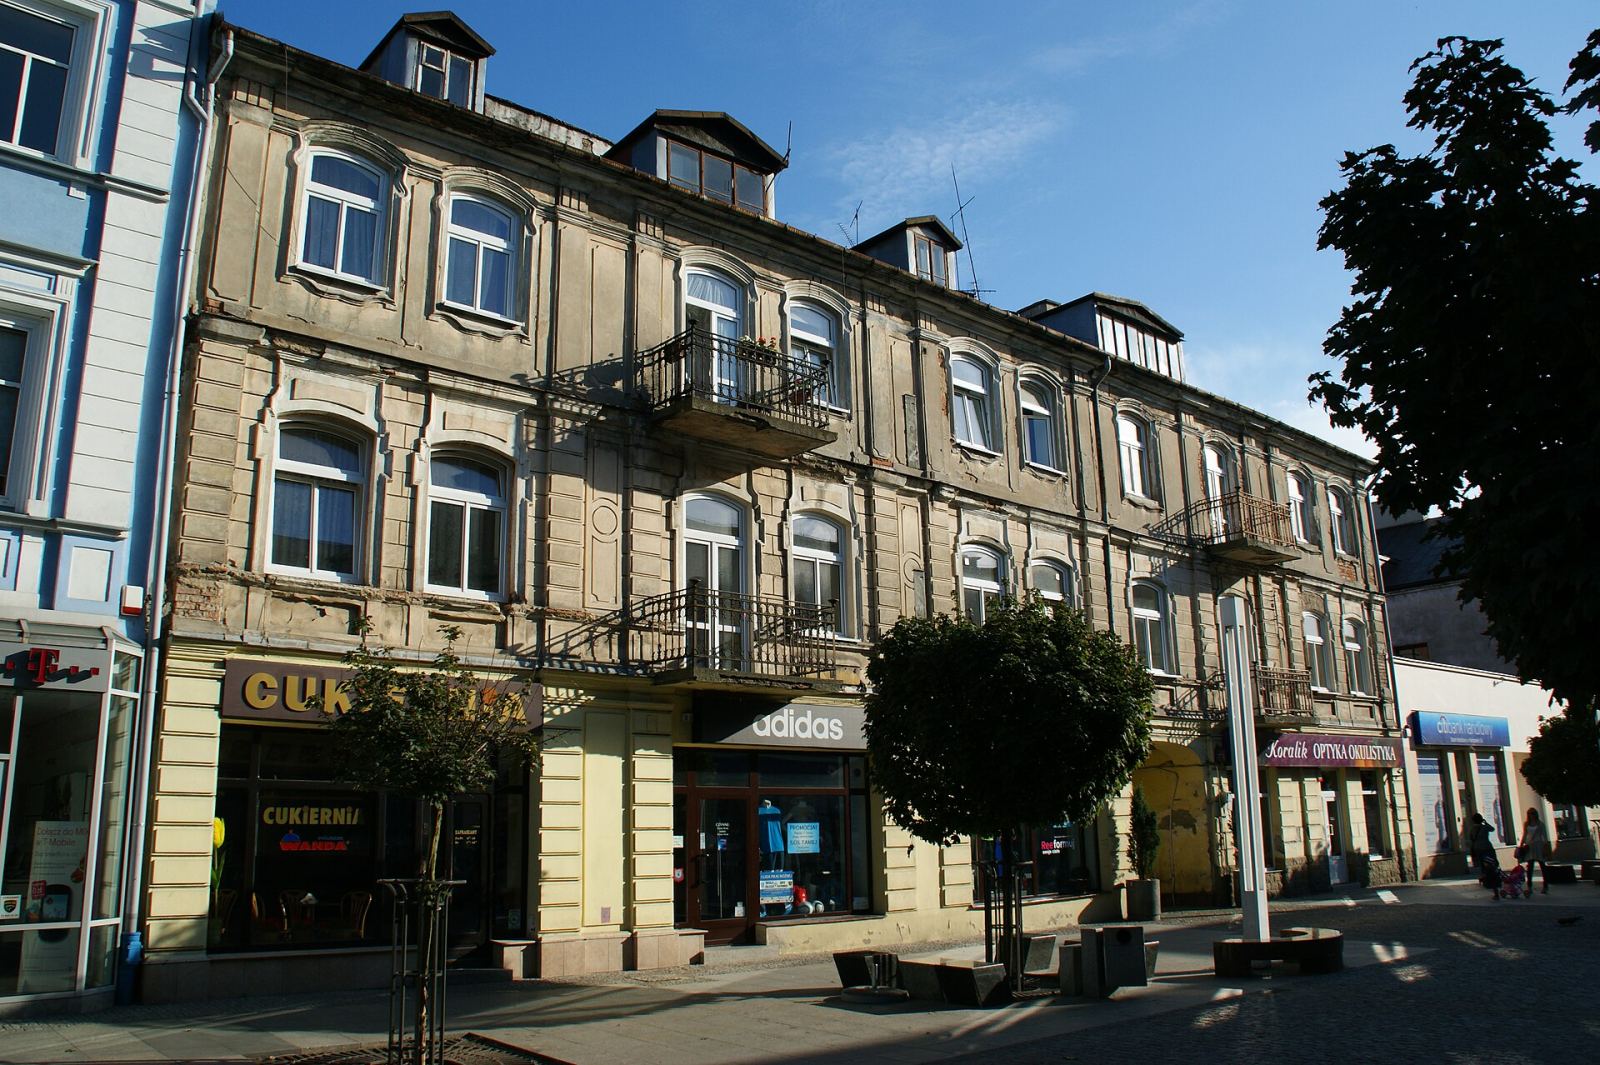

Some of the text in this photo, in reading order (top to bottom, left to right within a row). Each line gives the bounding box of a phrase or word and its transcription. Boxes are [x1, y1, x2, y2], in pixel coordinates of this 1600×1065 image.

[28, 647, 60, 684] T
[753, 709, 844, 740] adidas
[1265, 740, 1397, 761] Koralik OPTYKA OKULISTYKA
[280, 839, 348, 851] WANDA
